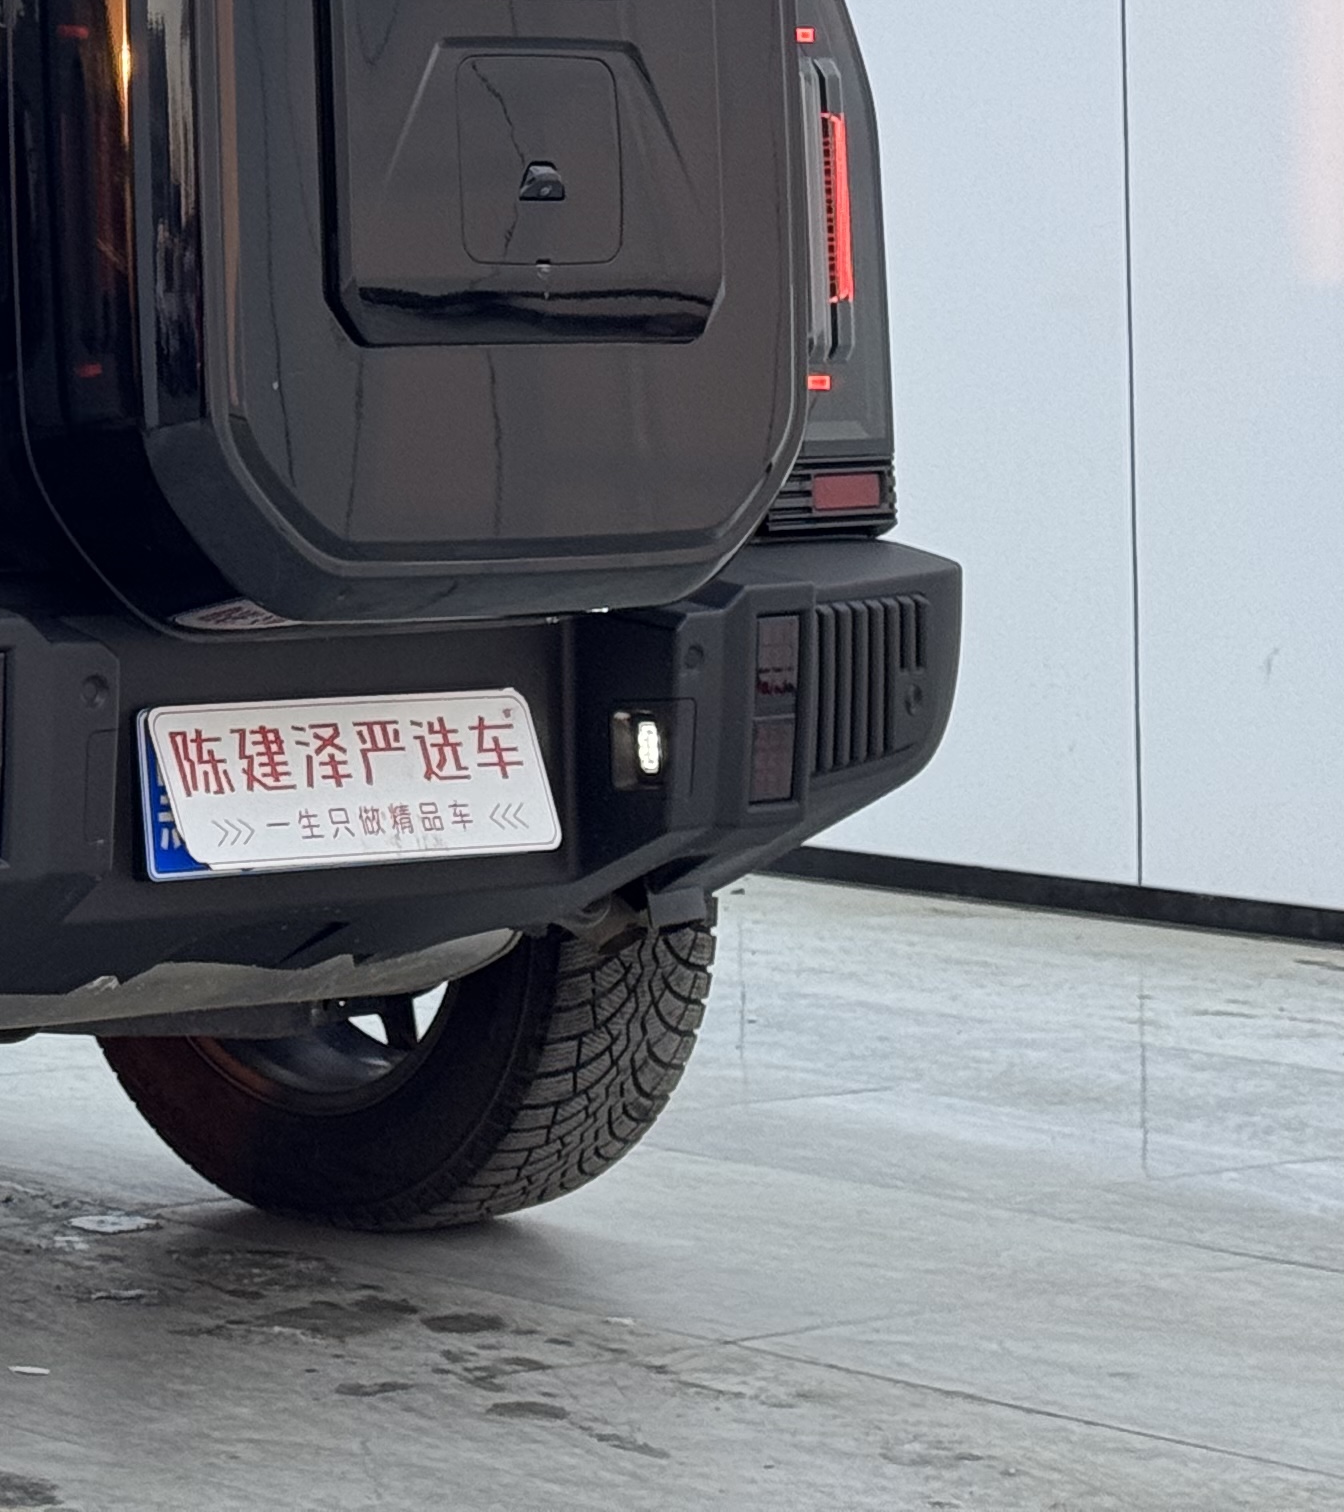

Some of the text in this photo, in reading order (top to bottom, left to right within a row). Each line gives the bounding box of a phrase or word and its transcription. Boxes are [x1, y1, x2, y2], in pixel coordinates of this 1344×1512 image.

[169, 715, 524, 798] 陈建泽严选车
[266, 800, 474, 840] 一生只做精品车
